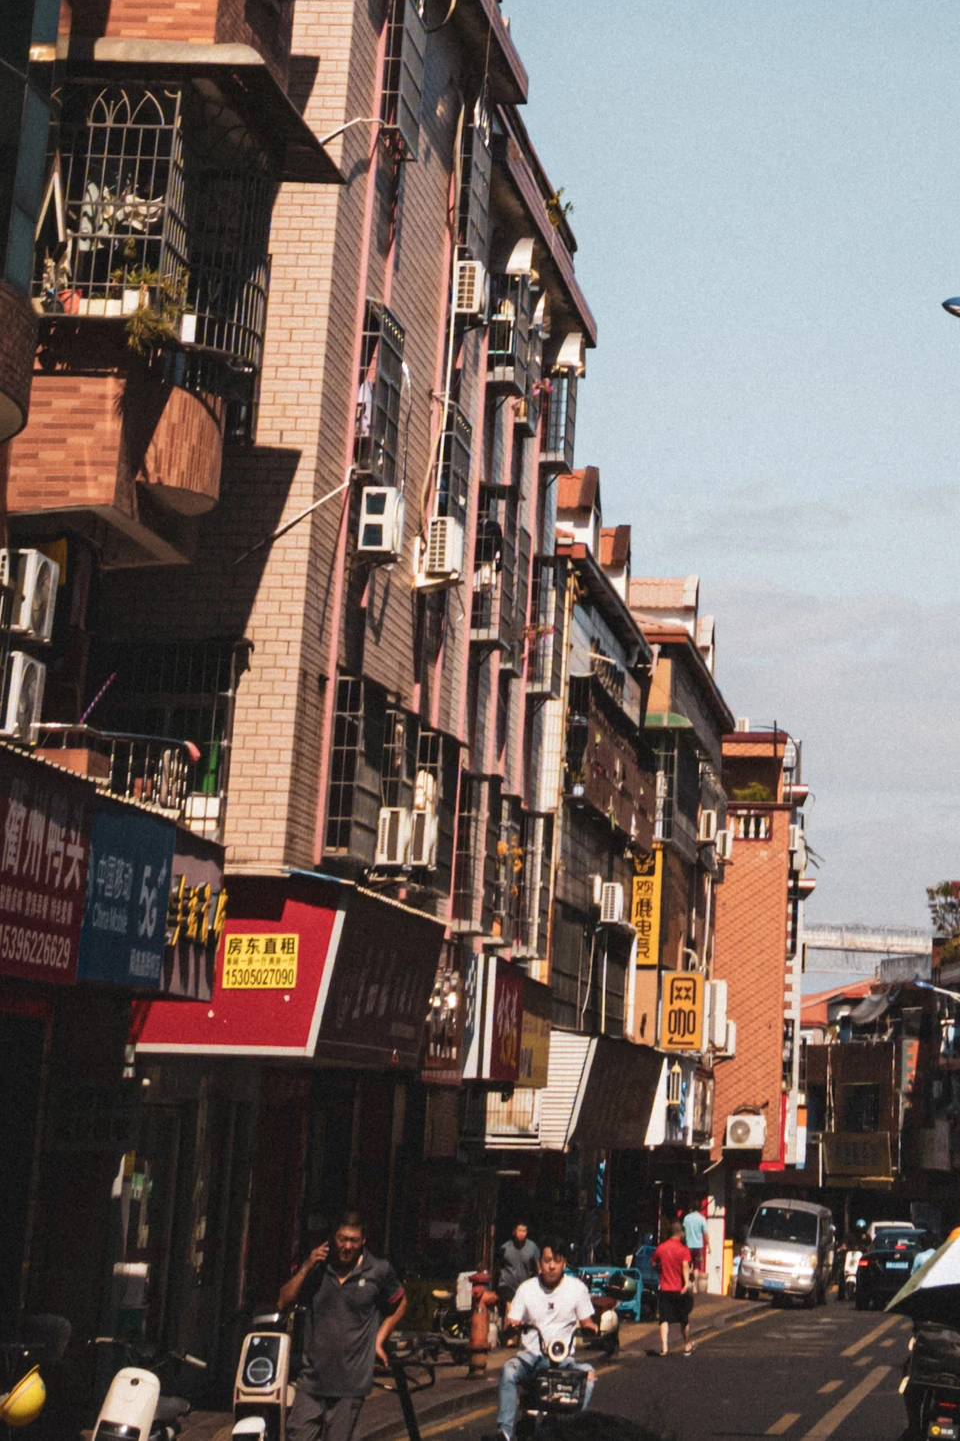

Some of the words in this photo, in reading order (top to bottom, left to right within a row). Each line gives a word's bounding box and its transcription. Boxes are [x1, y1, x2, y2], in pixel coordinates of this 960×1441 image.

[227, 937, 296, 955] 房东直租
[225, 968, 294, 986] 15305027090
[668, 976, 697, 1039] 网咖
